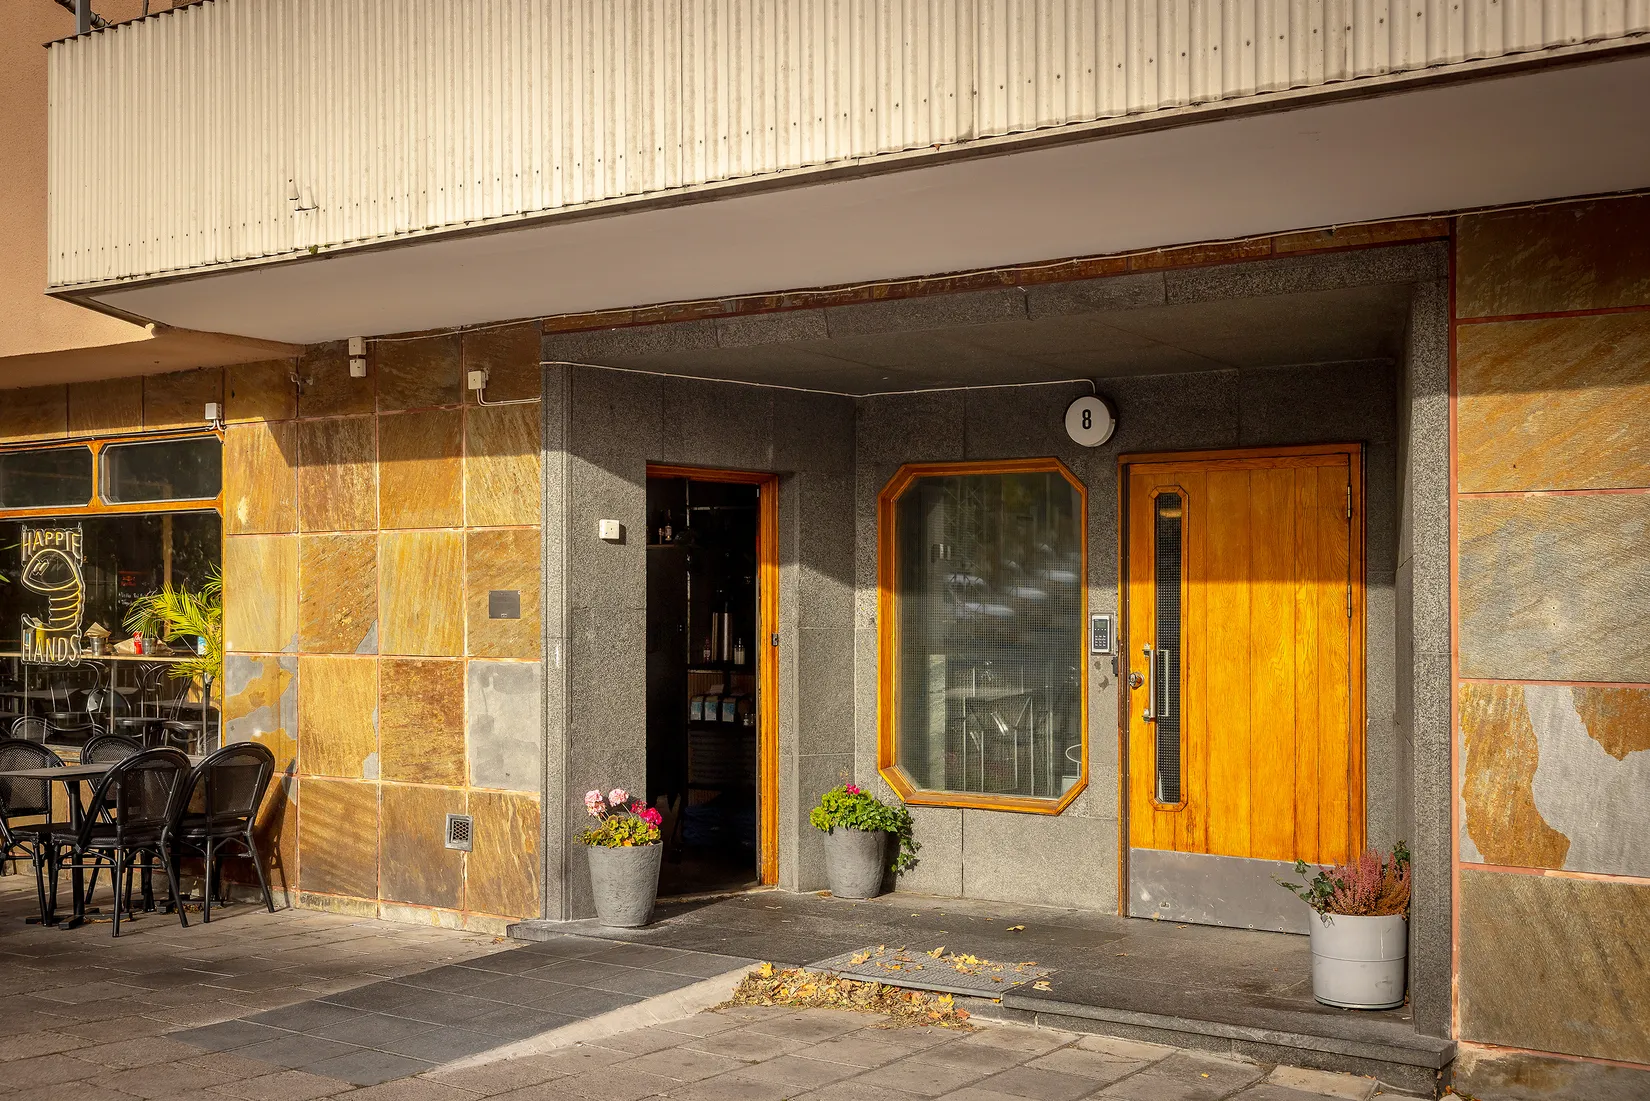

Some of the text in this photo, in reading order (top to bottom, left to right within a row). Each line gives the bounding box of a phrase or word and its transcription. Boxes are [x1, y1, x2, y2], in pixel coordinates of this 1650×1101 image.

[1082, 409, 1092, 430] 8
[22, 530, 82, 561] HAPPIE
[22, 629, 80, 662] HANDS
